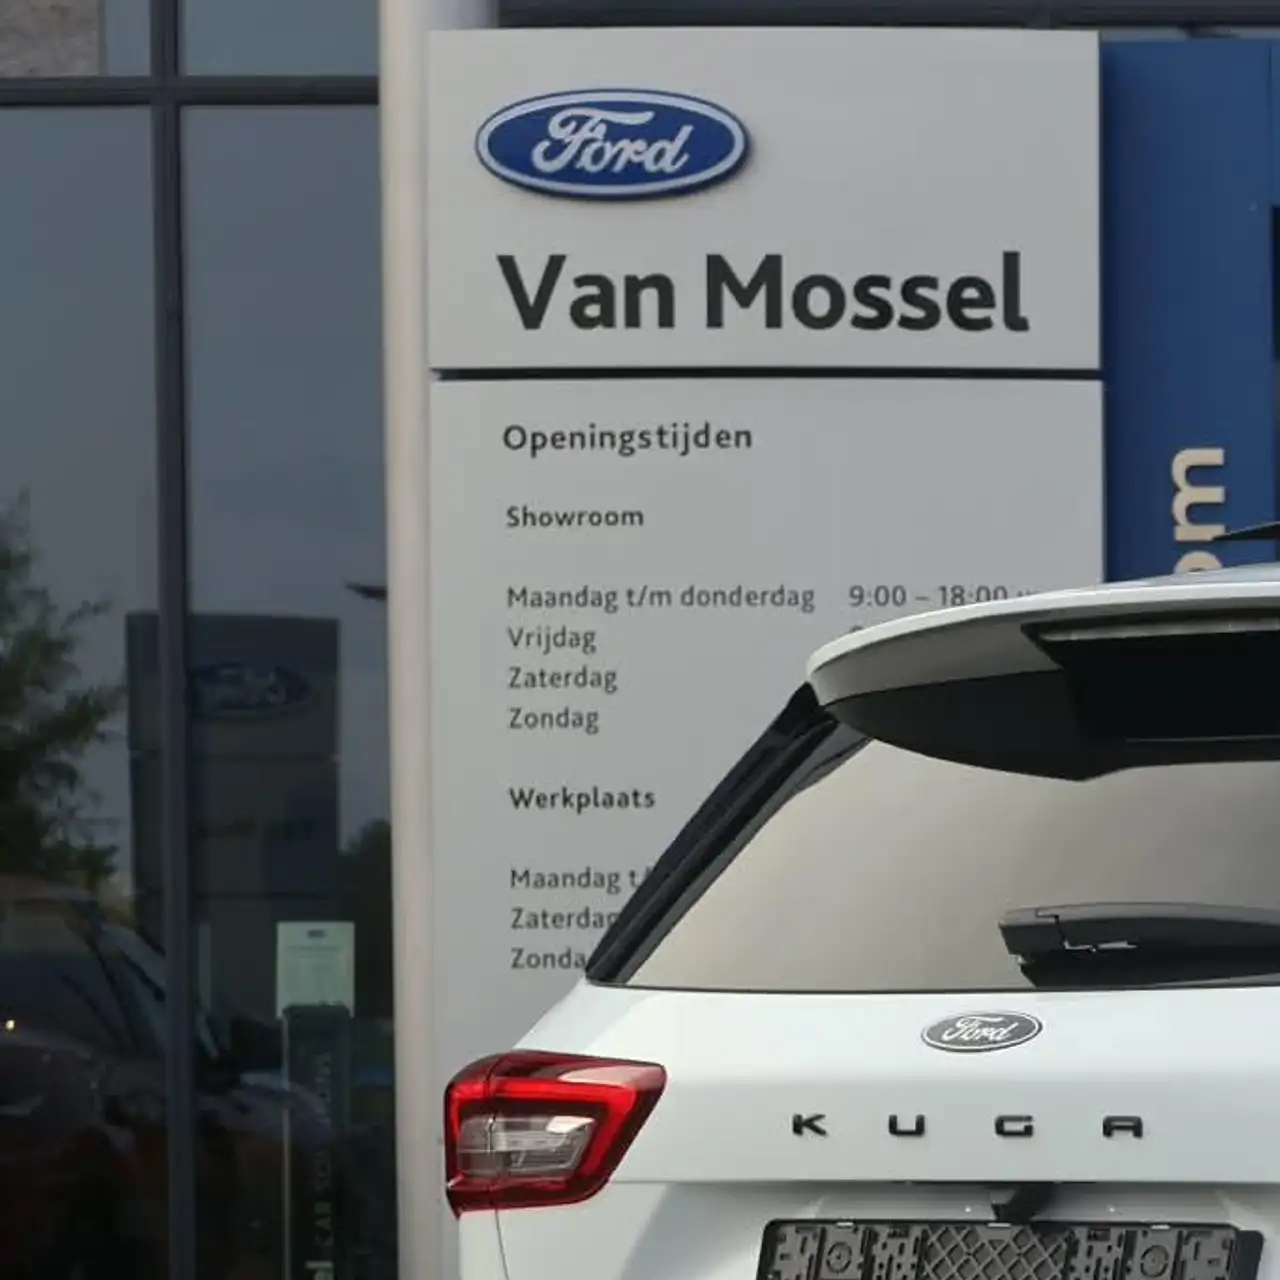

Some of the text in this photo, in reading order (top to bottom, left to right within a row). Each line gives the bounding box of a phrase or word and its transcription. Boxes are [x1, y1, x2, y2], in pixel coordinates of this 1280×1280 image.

[531, 106, 694, 174] Ford
[497, 250, 1030, 332] Van Mossel
[503, 421, 754, 459] Openingstijden
[506, 506, 645, 528] Showroom
[506, 586, 619, 615] Maandag
[626, 585, 672, 608] t/m
[680, 585, 816, 615] donderdag
[848, 585, 908, 608] 9:00
[938, 585, 1009, 607] 18:00
[507, 626, 598, 655] Vrijdag
[508, 667, 619, 694] Zaterdag
[509, 707, 601, 735] Zondag
[510, 786, 657, 815] Werkplaats
[510, 866, 622, 895] Maandag
[510, 948, 587, 970] Zonda
[940, 1015, 1013, 1044] Ford
[792, 1112, 1144, 1138] KUGA
